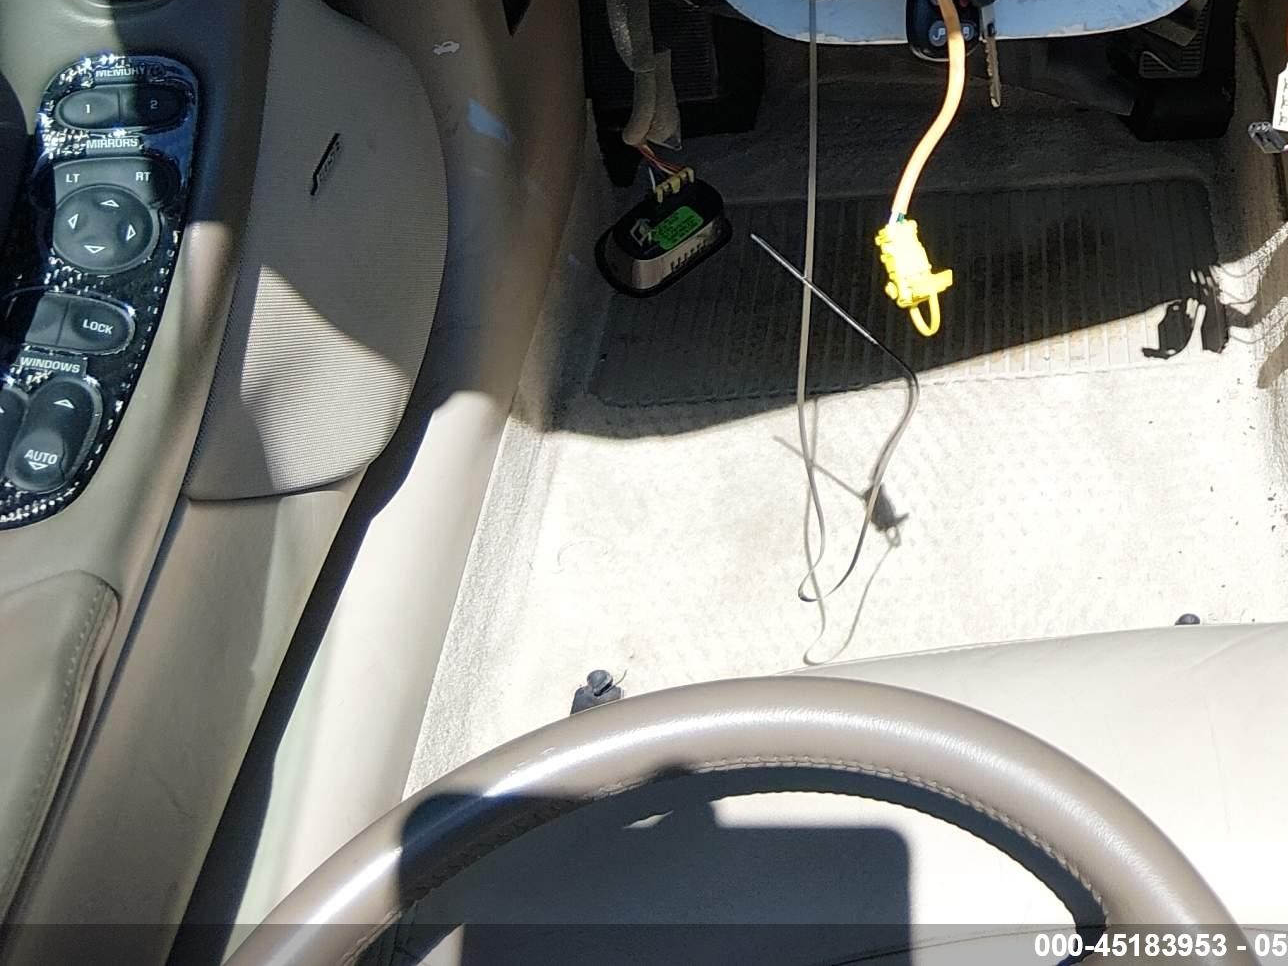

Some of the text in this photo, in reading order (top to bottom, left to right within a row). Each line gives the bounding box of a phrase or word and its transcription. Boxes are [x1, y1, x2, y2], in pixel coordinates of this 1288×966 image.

[96, 67, 146, 77] MEMORY
[151, 100, 158, 109] 2
[86, 139, 138, 149] MIRRORS
[66, 174, 80, 183] LT
[136, 172, 151, 181] RT
[83, 319, 113, 334] LOCK
[19, 357, 80, 373] WINDOWS
[24, 450, 58, 464] AUTO
